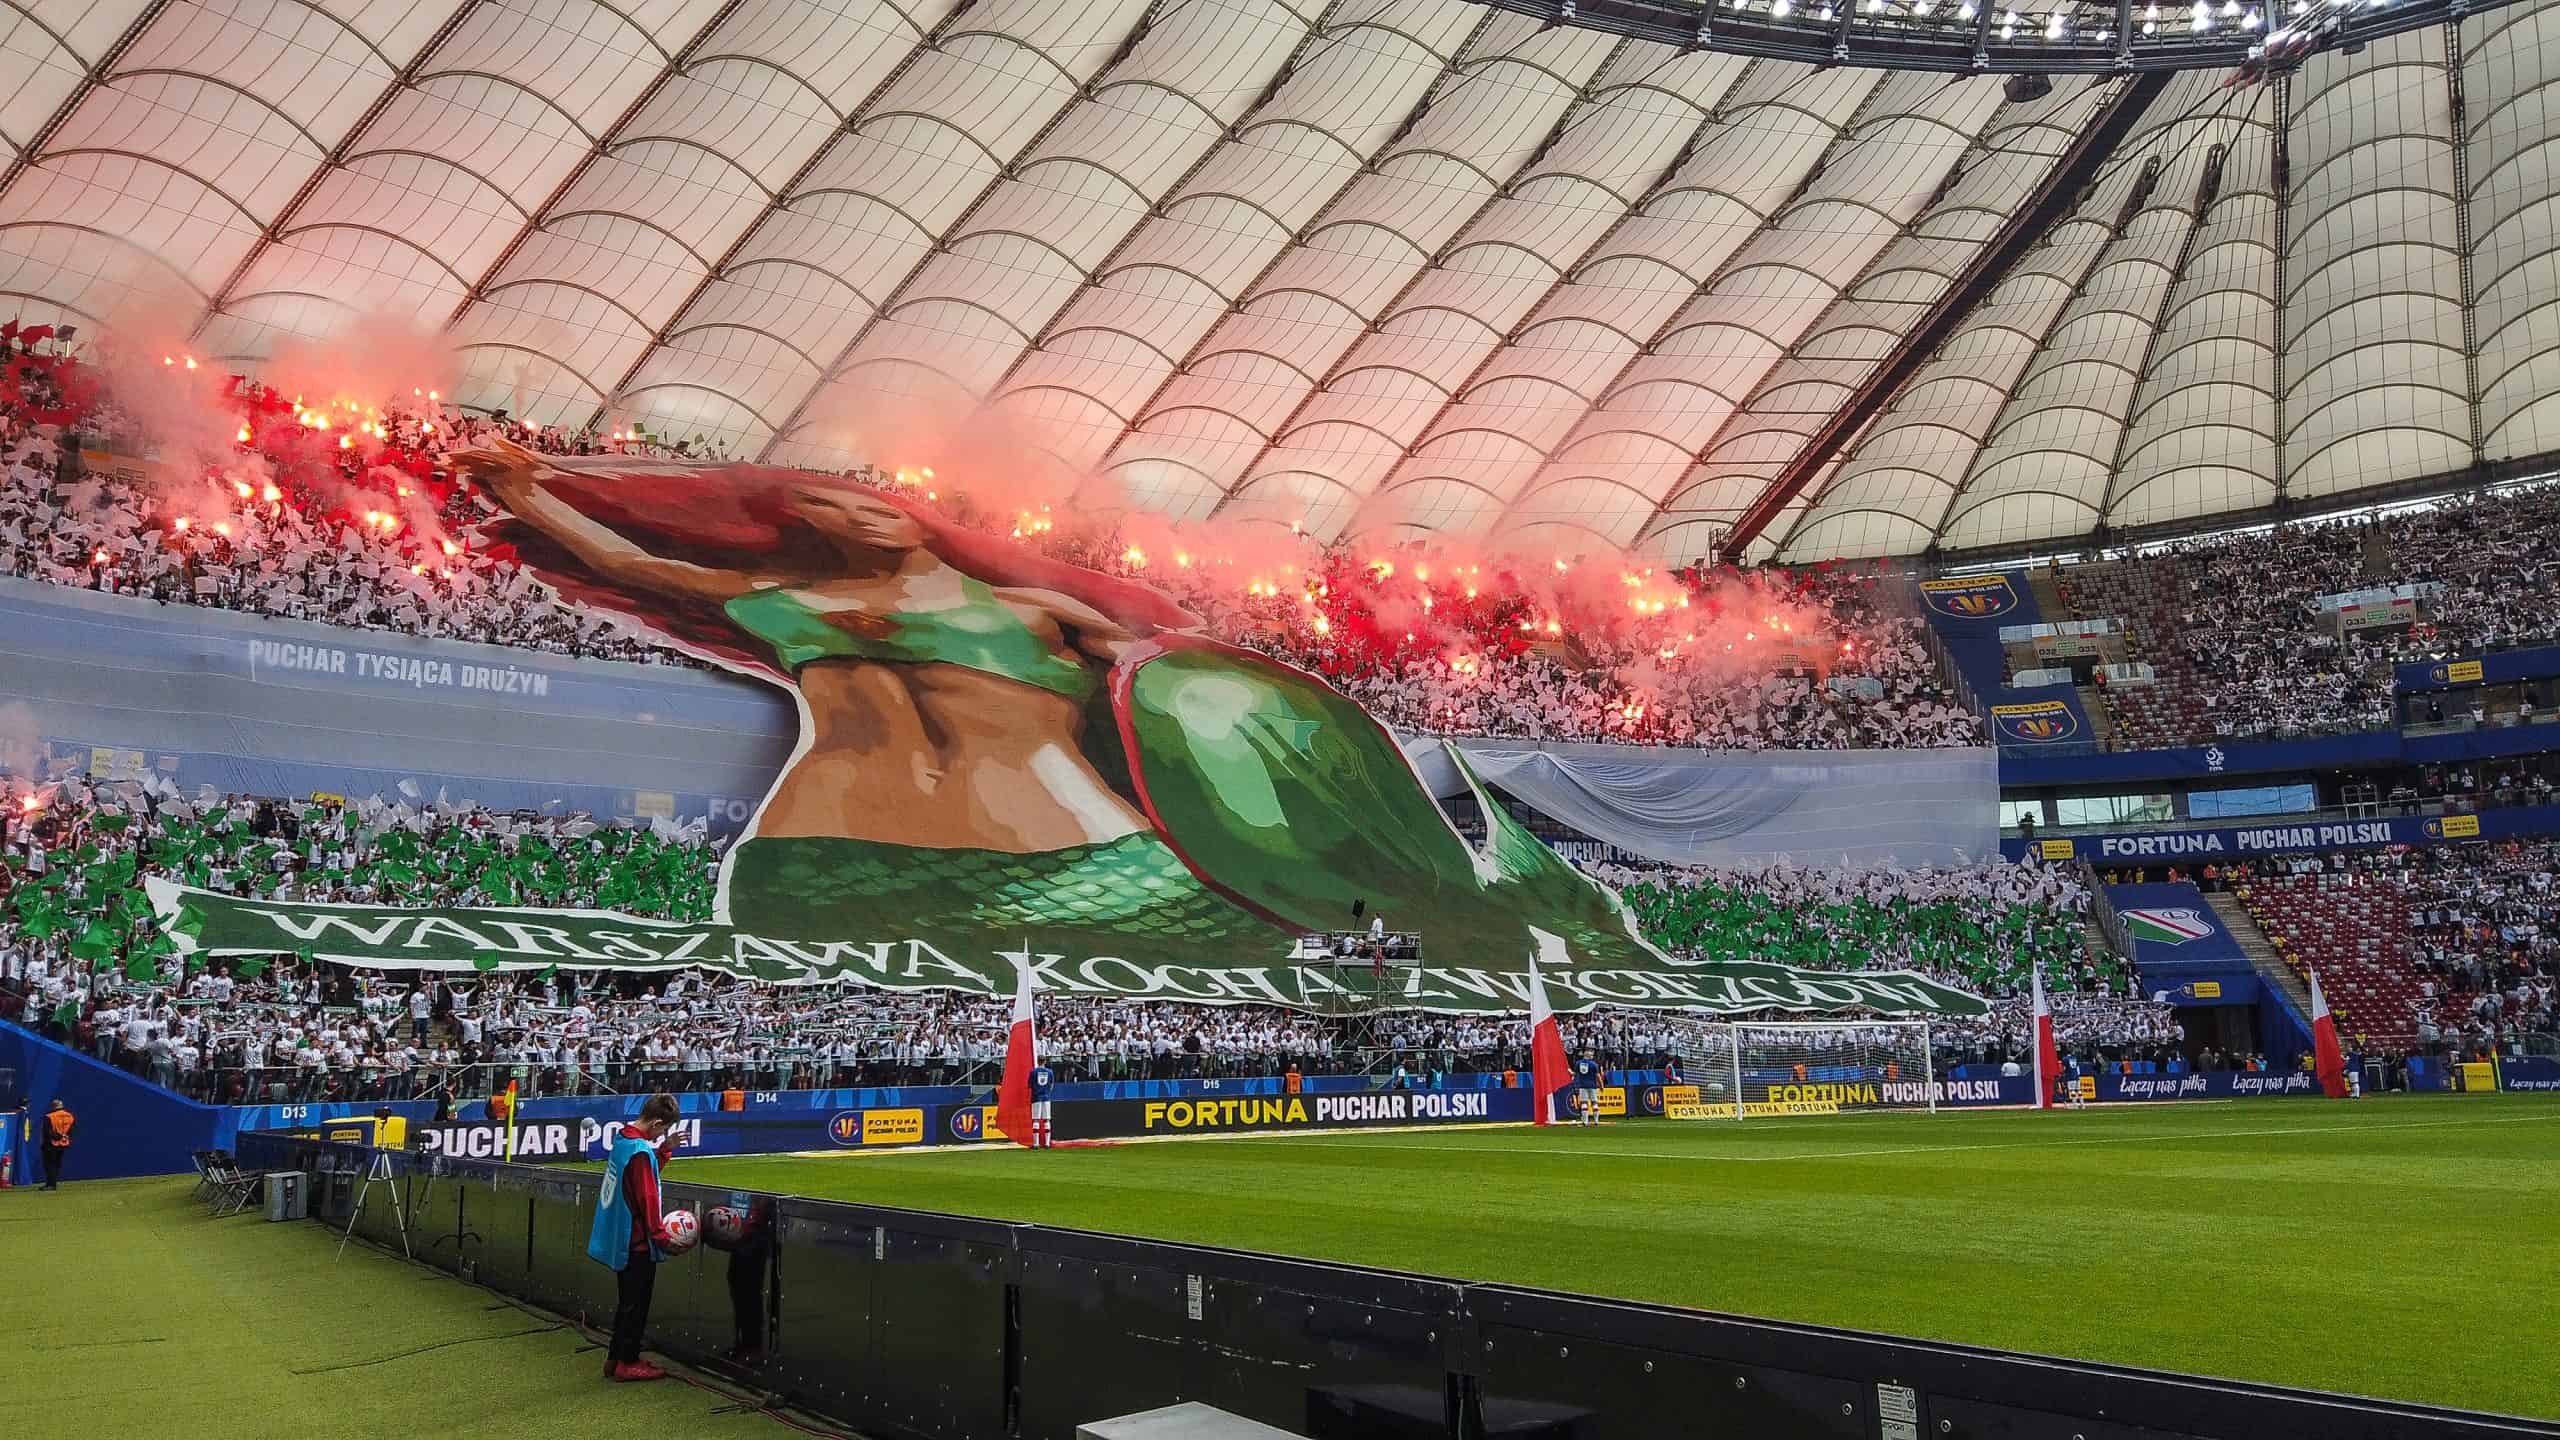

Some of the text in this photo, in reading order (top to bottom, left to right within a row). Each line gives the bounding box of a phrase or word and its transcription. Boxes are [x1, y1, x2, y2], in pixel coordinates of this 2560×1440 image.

[249, 639, 549, 697] PUCHAR TYSIĄCA DRUŻYN
[2102, 822, 2392, 857] FORTUNA PUCHAR POLSKI
[232, 906, 995, 991] WARSZAWA
[992, 950, 1373, 1007] KOCHA
[1203, 1080, 1220, 1090] D15
[1767, 1080, 2000, 1104] FORTUNA PUCHAR POLSKI
[2119, 1075, 2155, 1098] Łączy
[2156, 1080, 2177, 1094] nas
[2179, 1074, 2207, 1097] piłka
[2232, 1071, 2310, 1097] Łączy nas piłka
[755, 1092, 777, 1104] D14
[1787, 1103, 1834, 1113] FORTUNA
[282, 1106, 307, 1119] D13
[868, 1117, 918, 1127] FORTUNA
[1144, 1092, 1488, 1129] FORTUNA PUCHAR POLSKI
[1673, 1107, 1725, 1117] FORTUNA
[420, 1124, 568, 1158] PUCHAR
